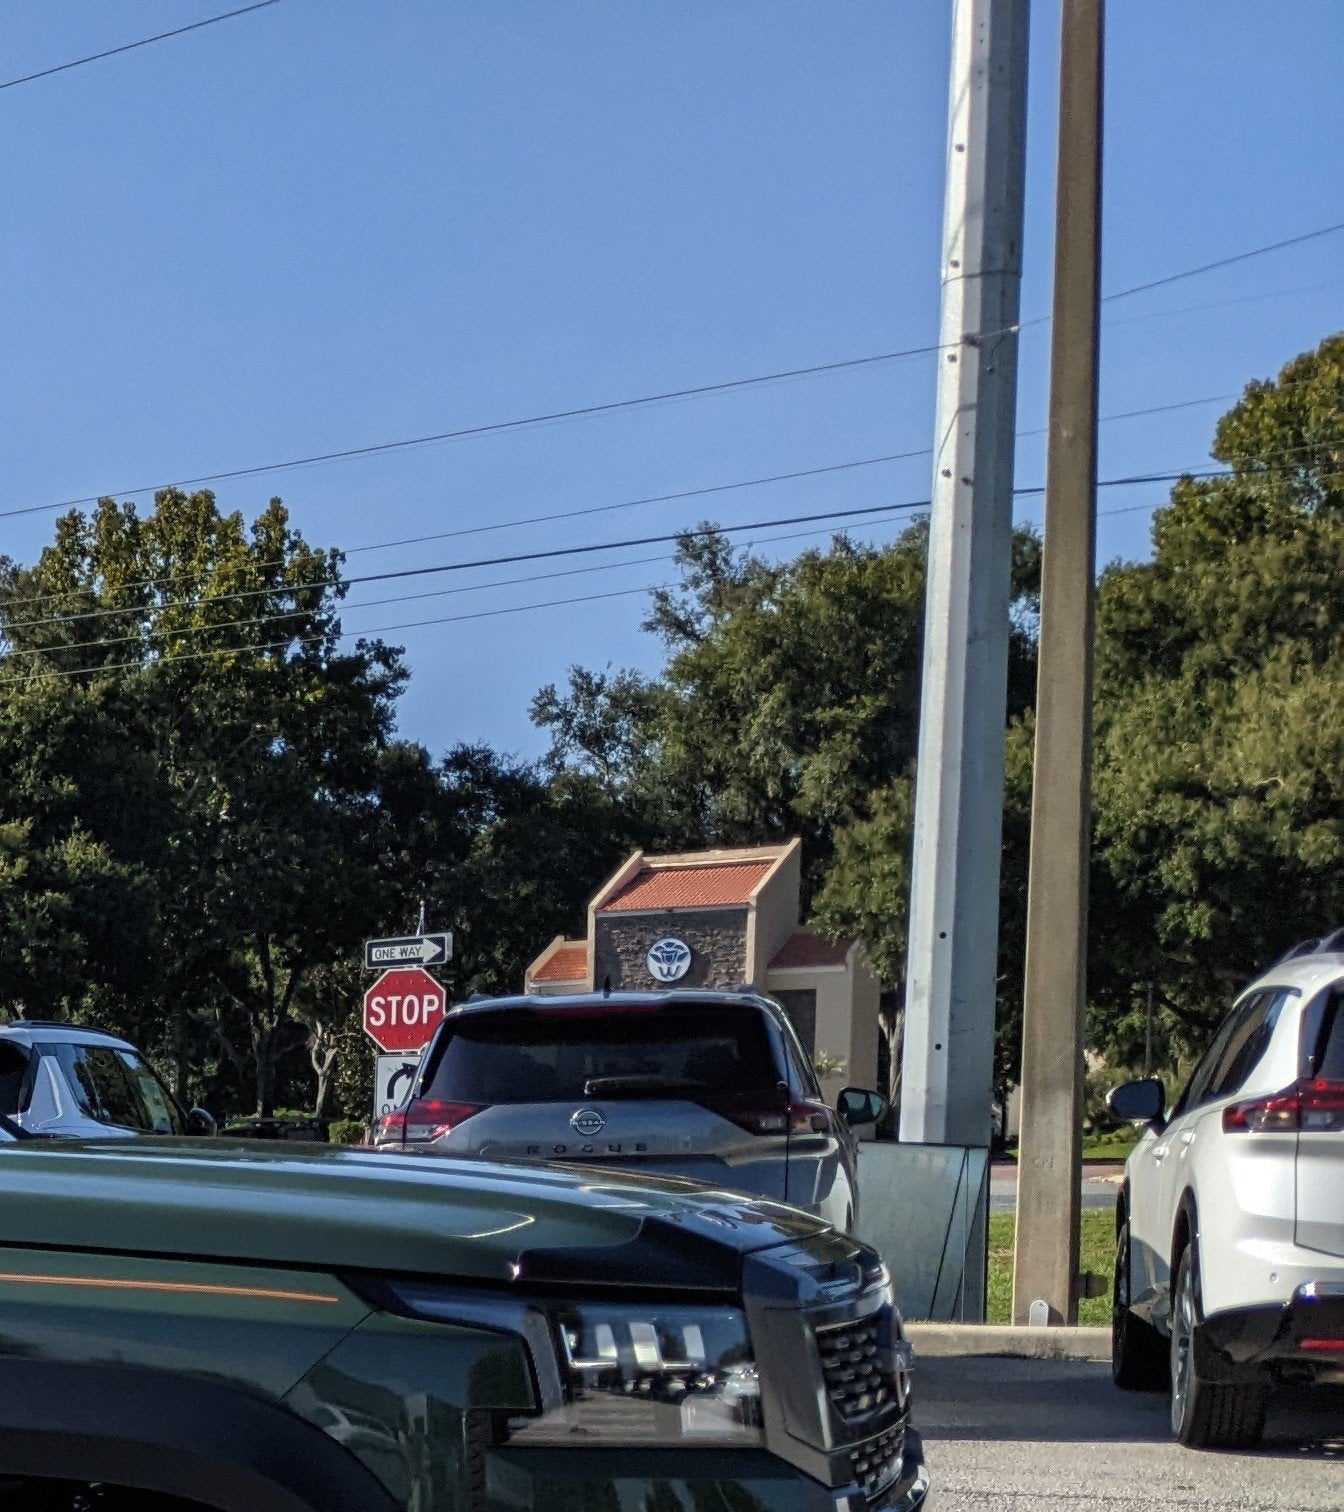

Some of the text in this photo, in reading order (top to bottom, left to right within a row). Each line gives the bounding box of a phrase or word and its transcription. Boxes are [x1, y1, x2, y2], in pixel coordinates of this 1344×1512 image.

[375, 947, 421, 959] ONE WAY
[369, 994, 440, 1026] STOP
[526, 1142, 648, 1155] ROGUE
